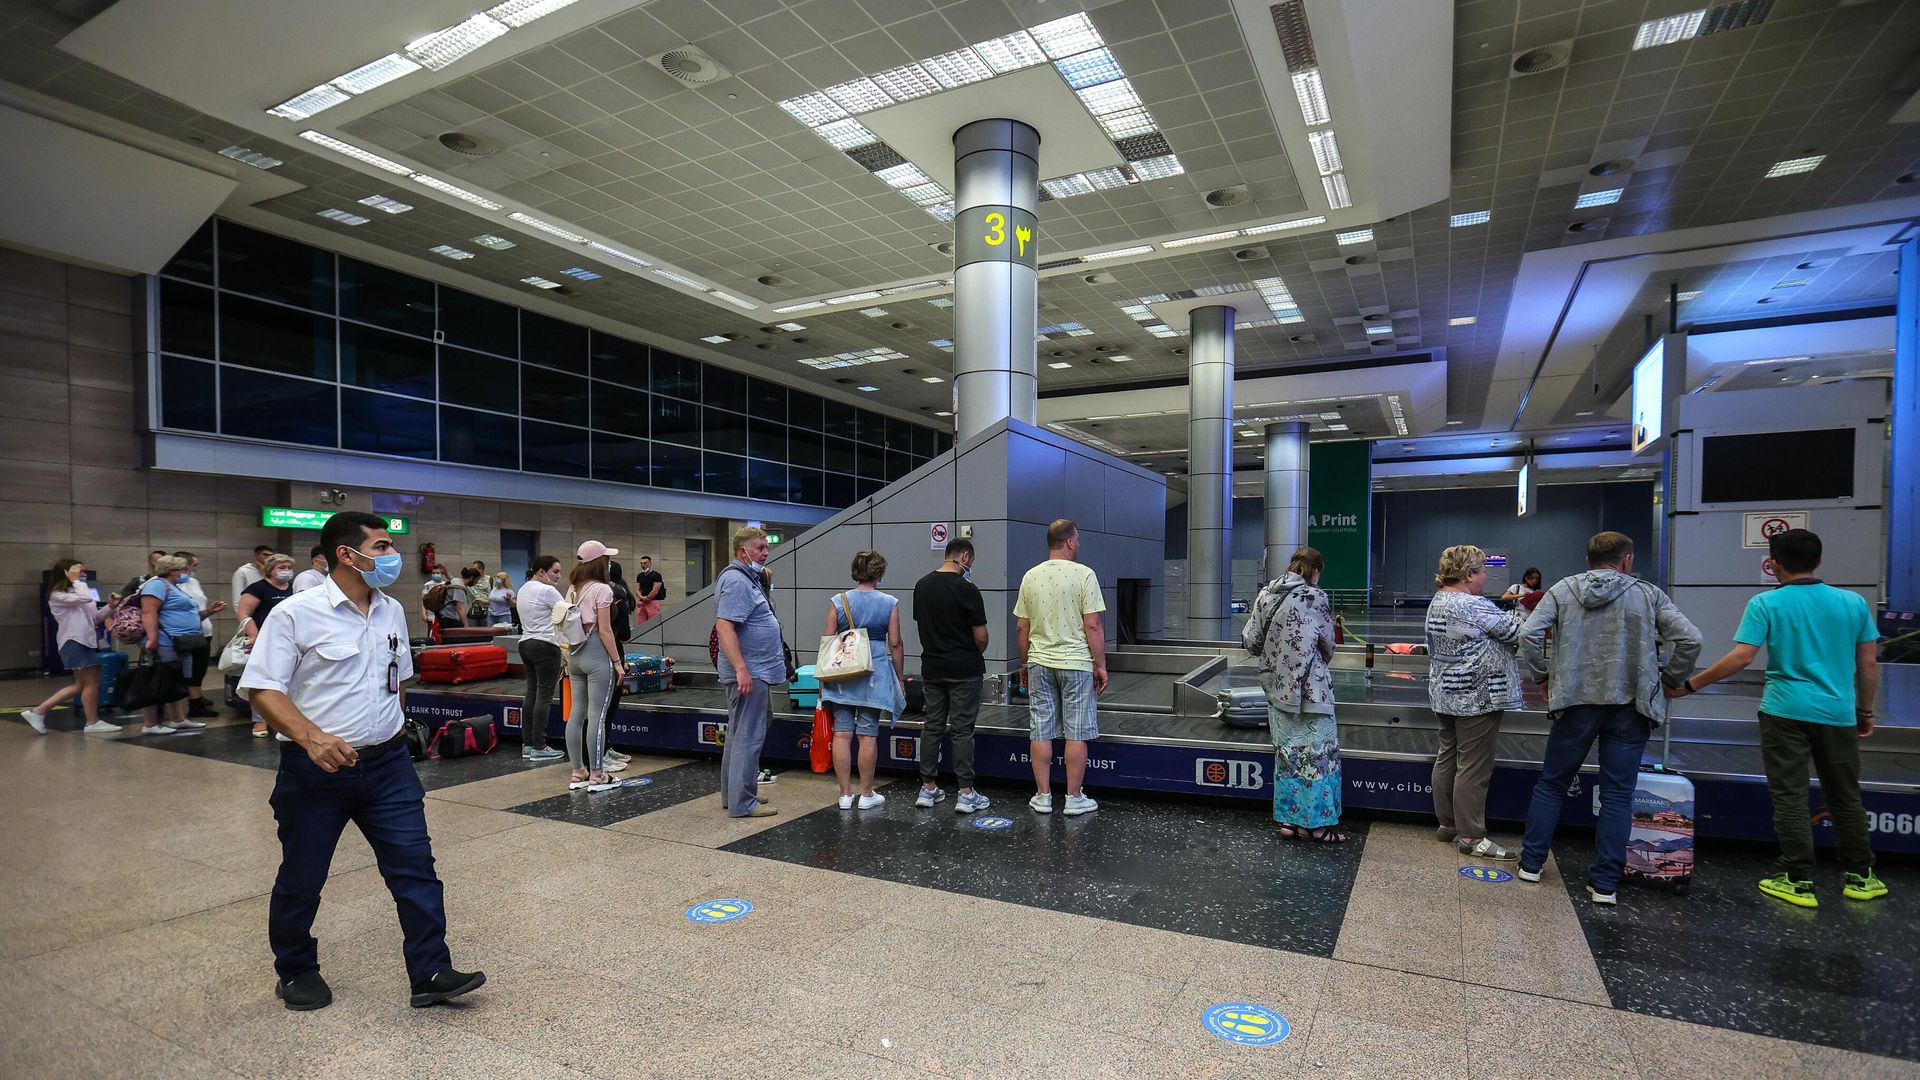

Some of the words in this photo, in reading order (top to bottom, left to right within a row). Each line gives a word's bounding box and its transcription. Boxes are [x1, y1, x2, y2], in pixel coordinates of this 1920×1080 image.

[985, 212, 1005, 246] 3
[1322, 513, 1357, 526] Print
[411, 706, 430, 715] BANK
[431, 708, 440, 716] TO
[441, 709, 463, 717] TRUST
[1009, 752, 1017, 762] A
[1085, 758, 1116, 770] RUST
[1195, 757, 1264, 790] CIB
